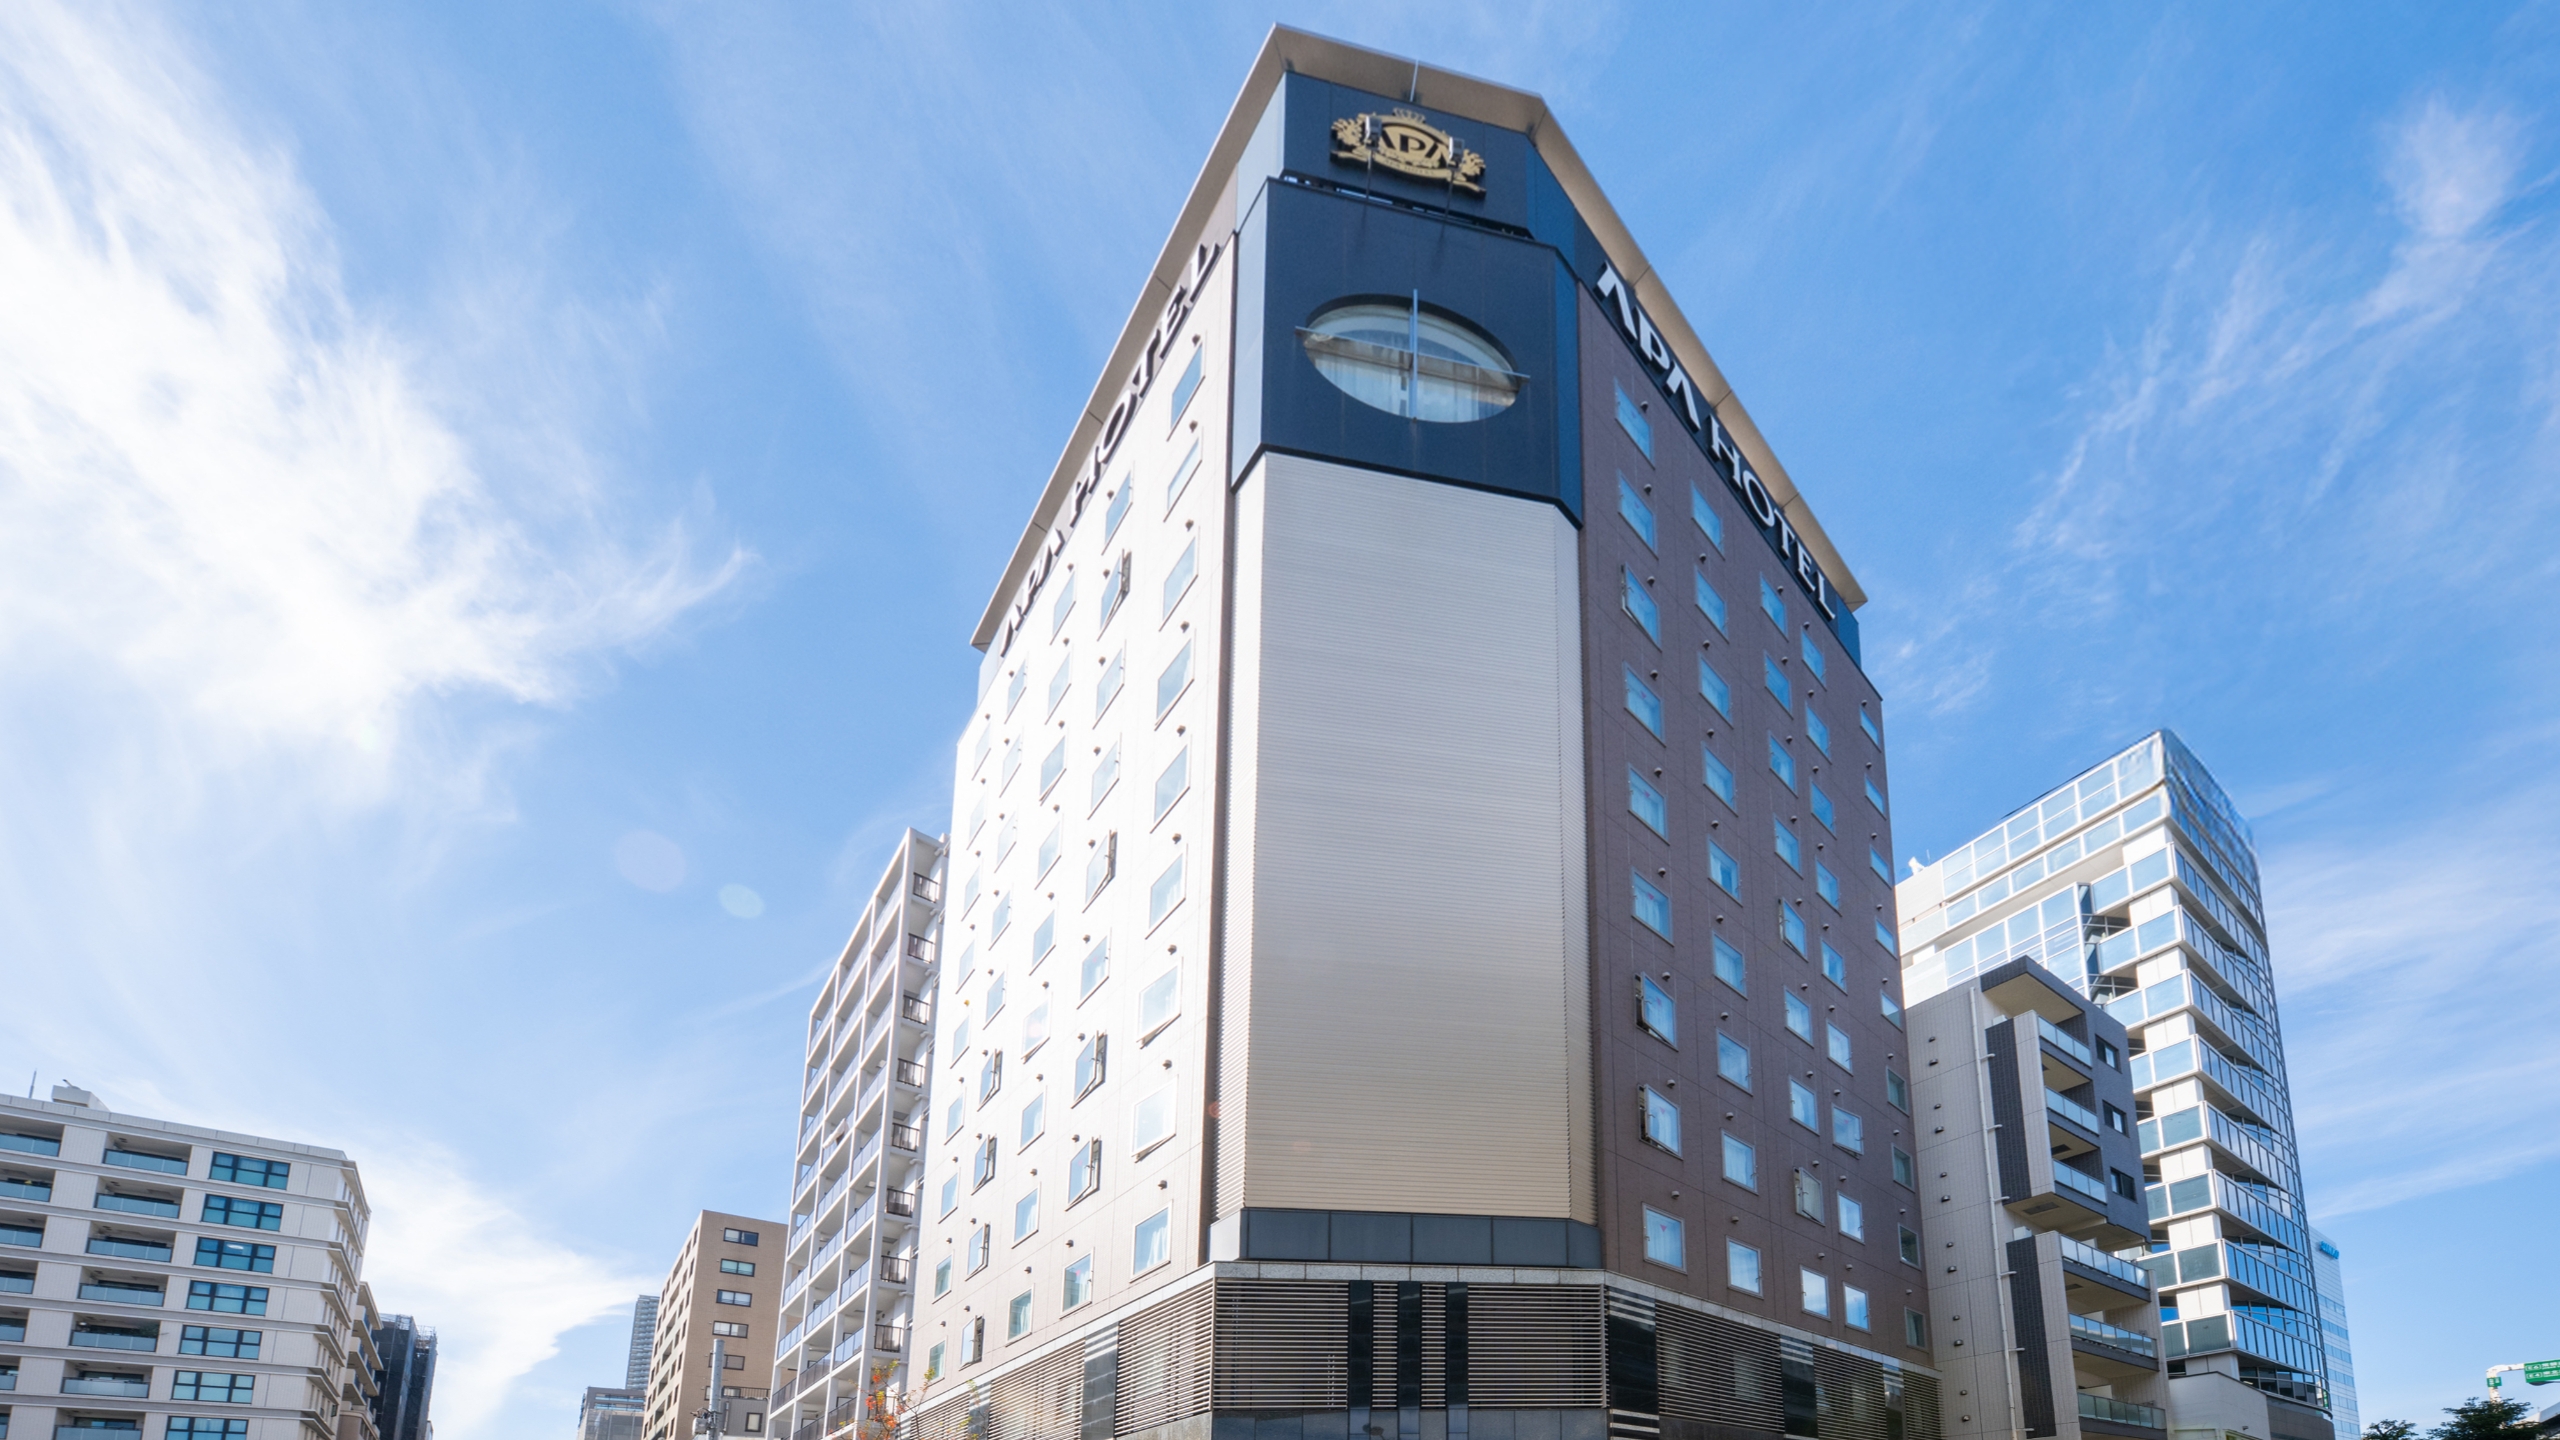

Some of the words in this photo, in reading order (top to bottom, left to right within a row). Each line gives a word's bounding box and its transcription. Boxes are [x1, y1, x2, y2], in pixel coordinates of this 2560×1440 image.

[999, 527, 1065, 658] APA
[1069, 243, 1221, 528] HOTEL
[1597, 259, 1701, 431] APA
[1708, 414, 1836, 620] HOTEL
